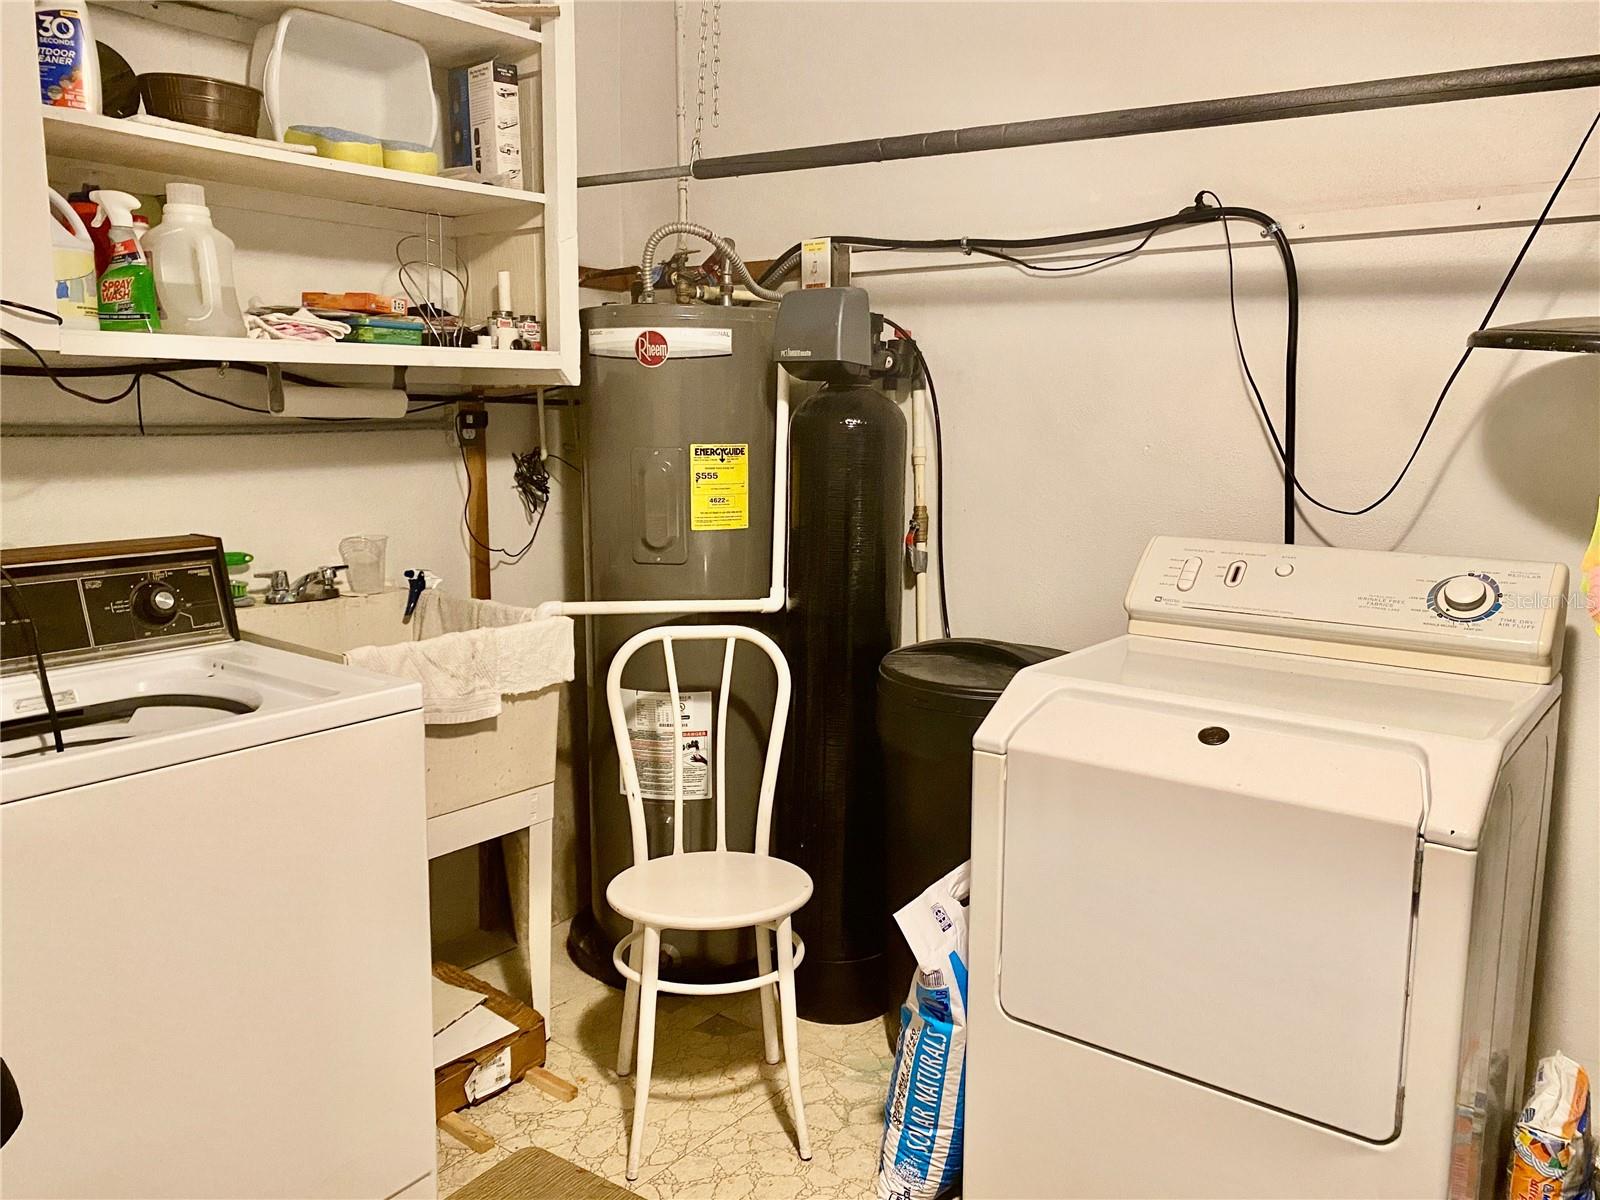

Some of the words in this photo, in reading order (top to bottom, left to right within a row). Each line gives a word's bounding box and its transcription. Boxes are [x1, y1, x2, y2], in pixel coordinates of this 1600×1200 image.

[39, 15, 75, 39] 30
[40, 36, 75, 47] SECONDS
[38, 47, 76, 58] TDOOR
[38, 55, 73, 66] EANER
[102, 279, 131, 292] SPRAY
[102, 289, 129, 302] WASH
[639, 330, 667, 361] Rheem
[695, 472, 719, 480] $555
[914, 1026, 947, 1107] NATURALS
[906, 1106, 936, 1152] SOLAR
